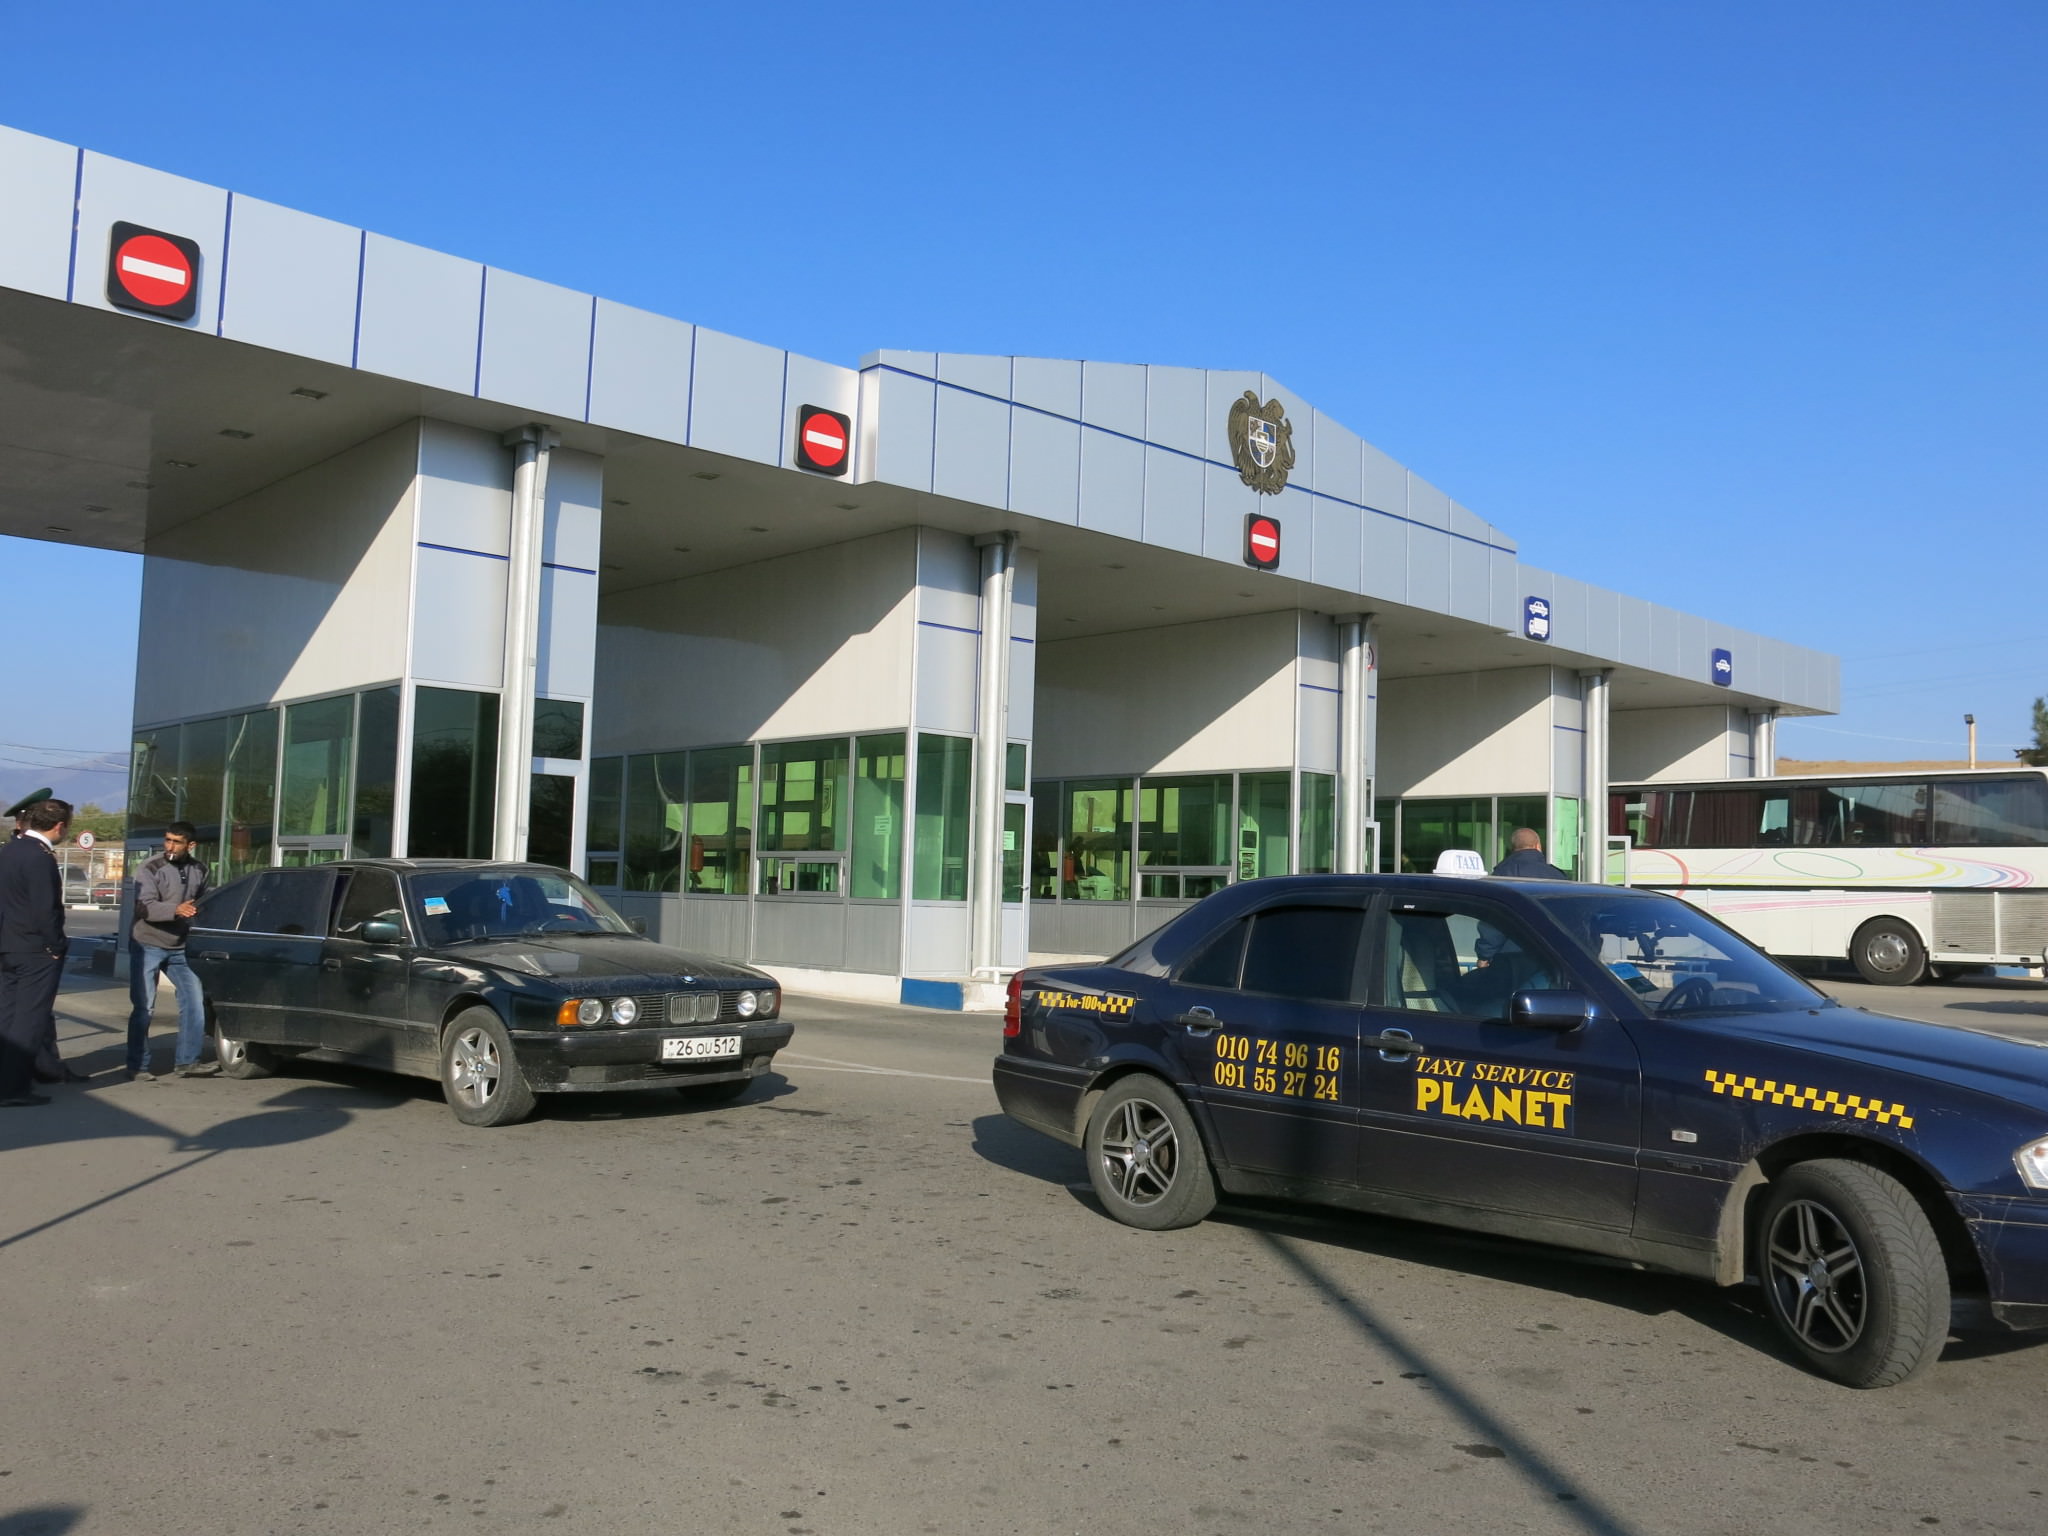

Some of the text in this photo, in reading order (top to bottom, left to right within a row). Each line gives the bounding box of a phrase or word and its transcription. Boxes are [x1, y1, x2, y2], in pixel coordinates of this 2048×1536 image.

[1455, 855, 1480, 870] TAXI
[676, 1040, 693, 1056] 26
[1216, 1034, 1340, 1072] 010 74 96 16
[1214, 1061, 1339, 1101] 091 55 27 24
[1415, 1056, 1574, 1090] TAXI SERVICE
[1416, 1078, 1572, 1130] PLANET
